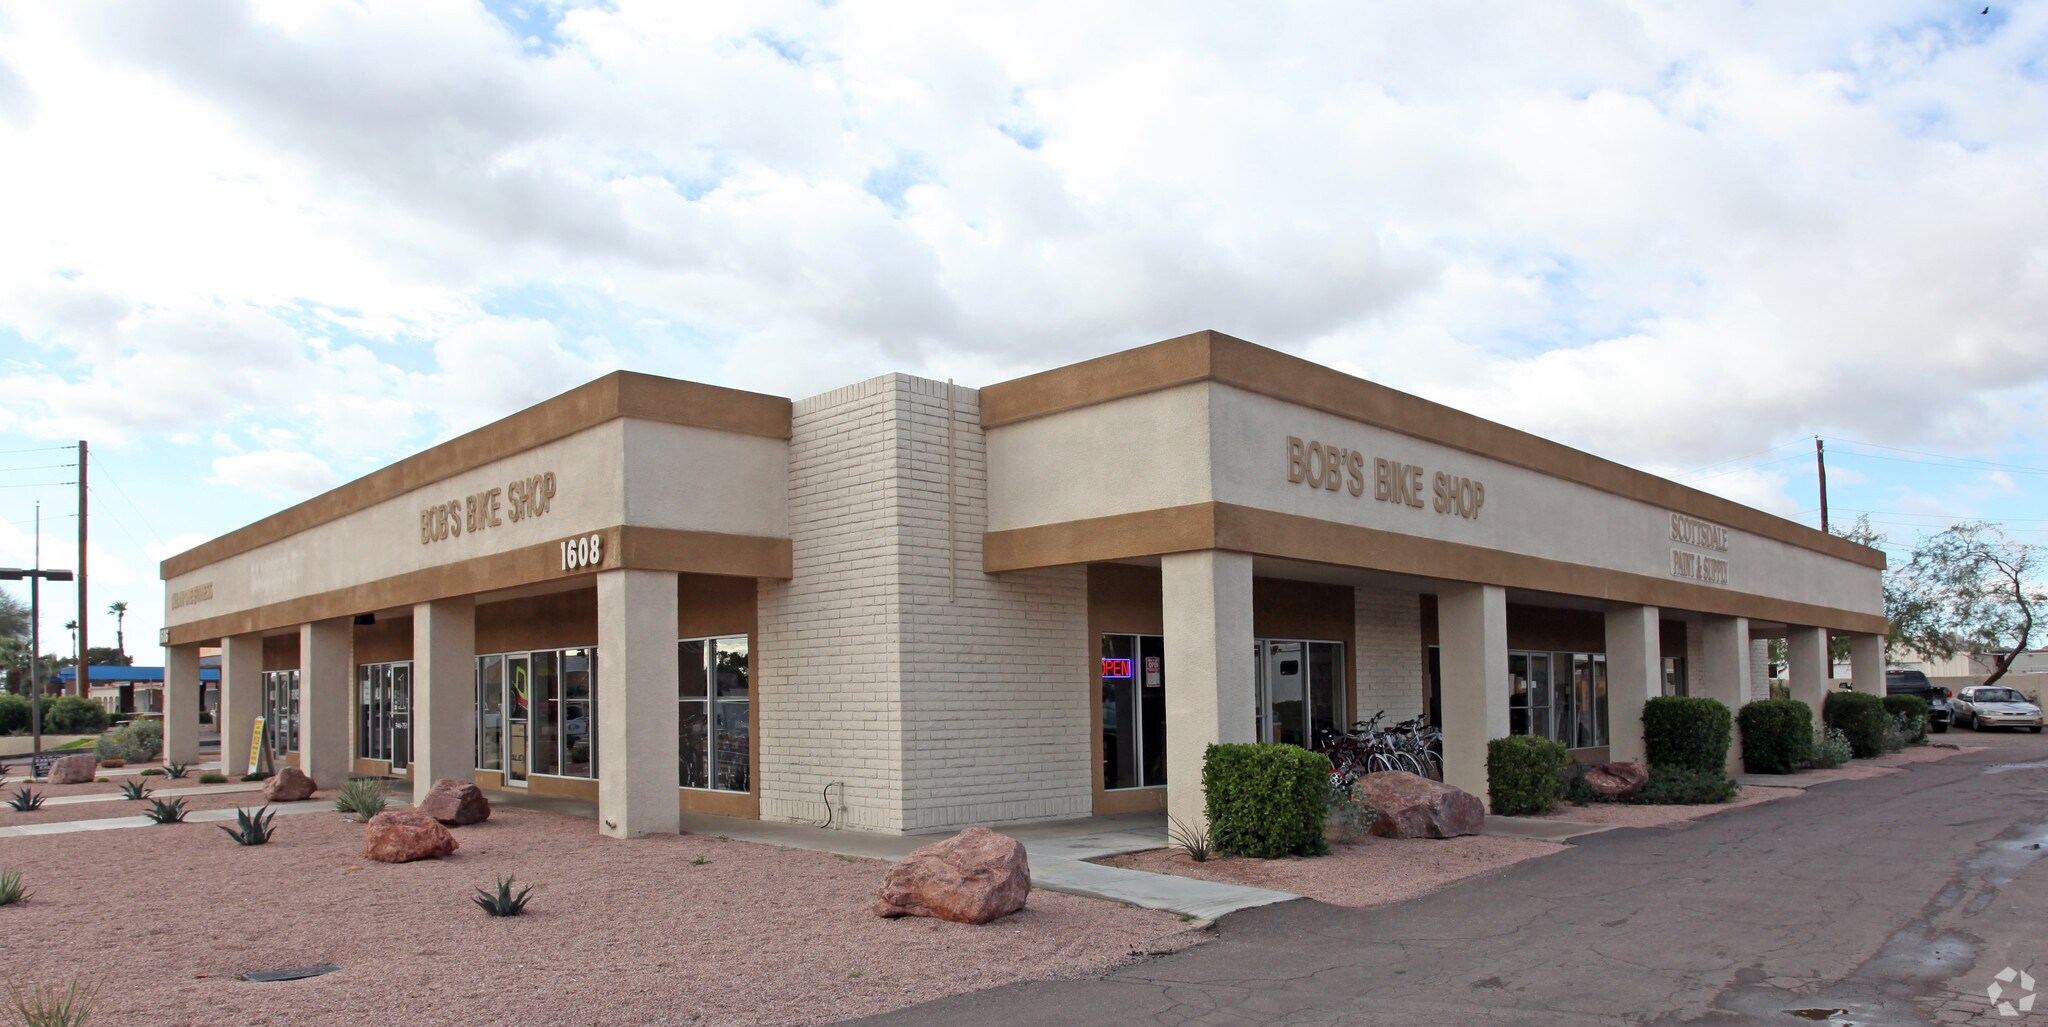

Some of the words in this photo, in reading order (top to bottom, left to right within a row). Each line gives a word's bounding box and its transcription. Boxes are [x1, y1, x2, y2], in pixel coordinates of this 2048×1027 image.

[1287, 435, 1364, 497] BOB'S
[1374, 457, 1425, 508] BIKE
[1433, 471, 1485, 519] SHOP
[420, 499, 461, 544] BOB'S
[466, 487, 502, 533] BIKE
[508, 471, 556, 523] SHOP
[1671, 512, 1728, 552] SCOTTSDALE
[560, 534, 602, 571] 1608
[1672, 549, 1695, 578] PAINT
[1696, 554, 1703, 580] &
[1703, 556, 1729, 584] SUPPLY
